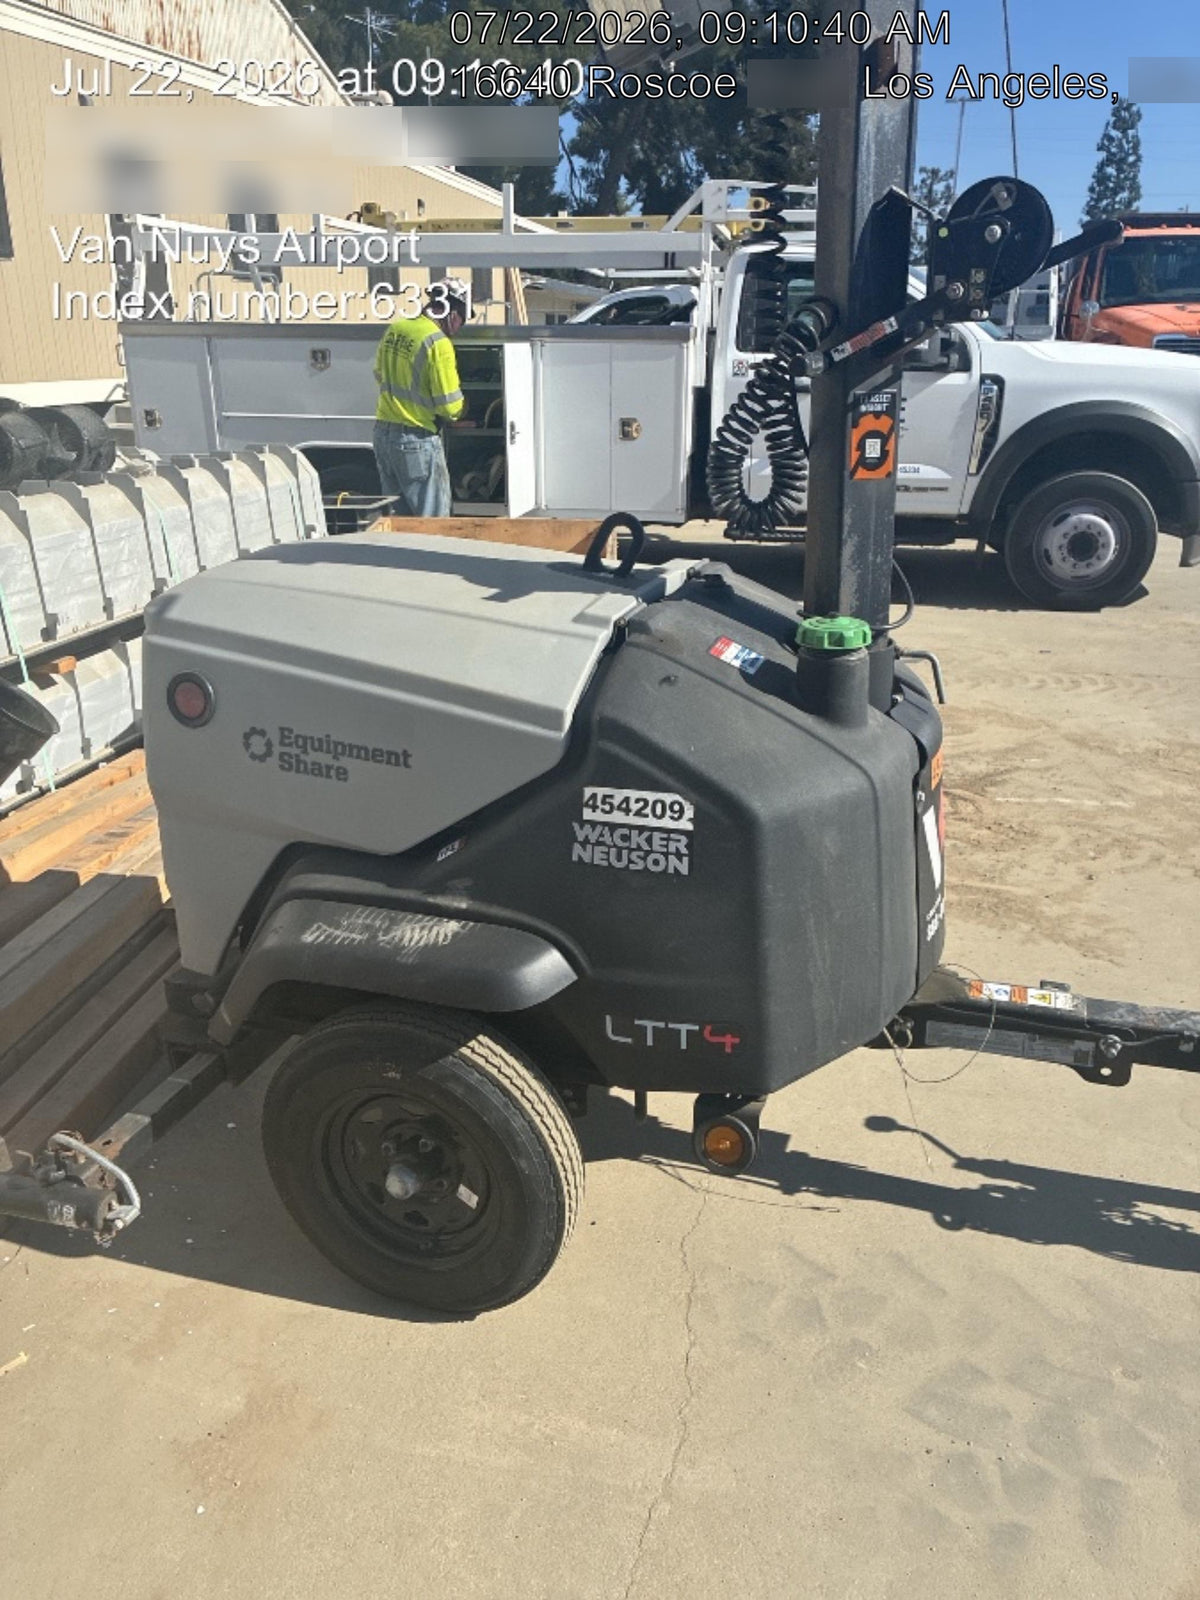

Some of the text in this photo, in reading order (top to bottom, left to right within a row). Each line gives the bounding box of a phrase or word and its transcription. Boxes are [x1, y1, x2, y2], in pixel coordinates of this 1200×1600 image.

[278, 726, 413, 769] Equipment
[278, 751, 349, 783] Share
[583, 792, 685, 822] 454209
[571, 821, 689, 855] WACKER
[571, 842, 689, 876] NEUSON
